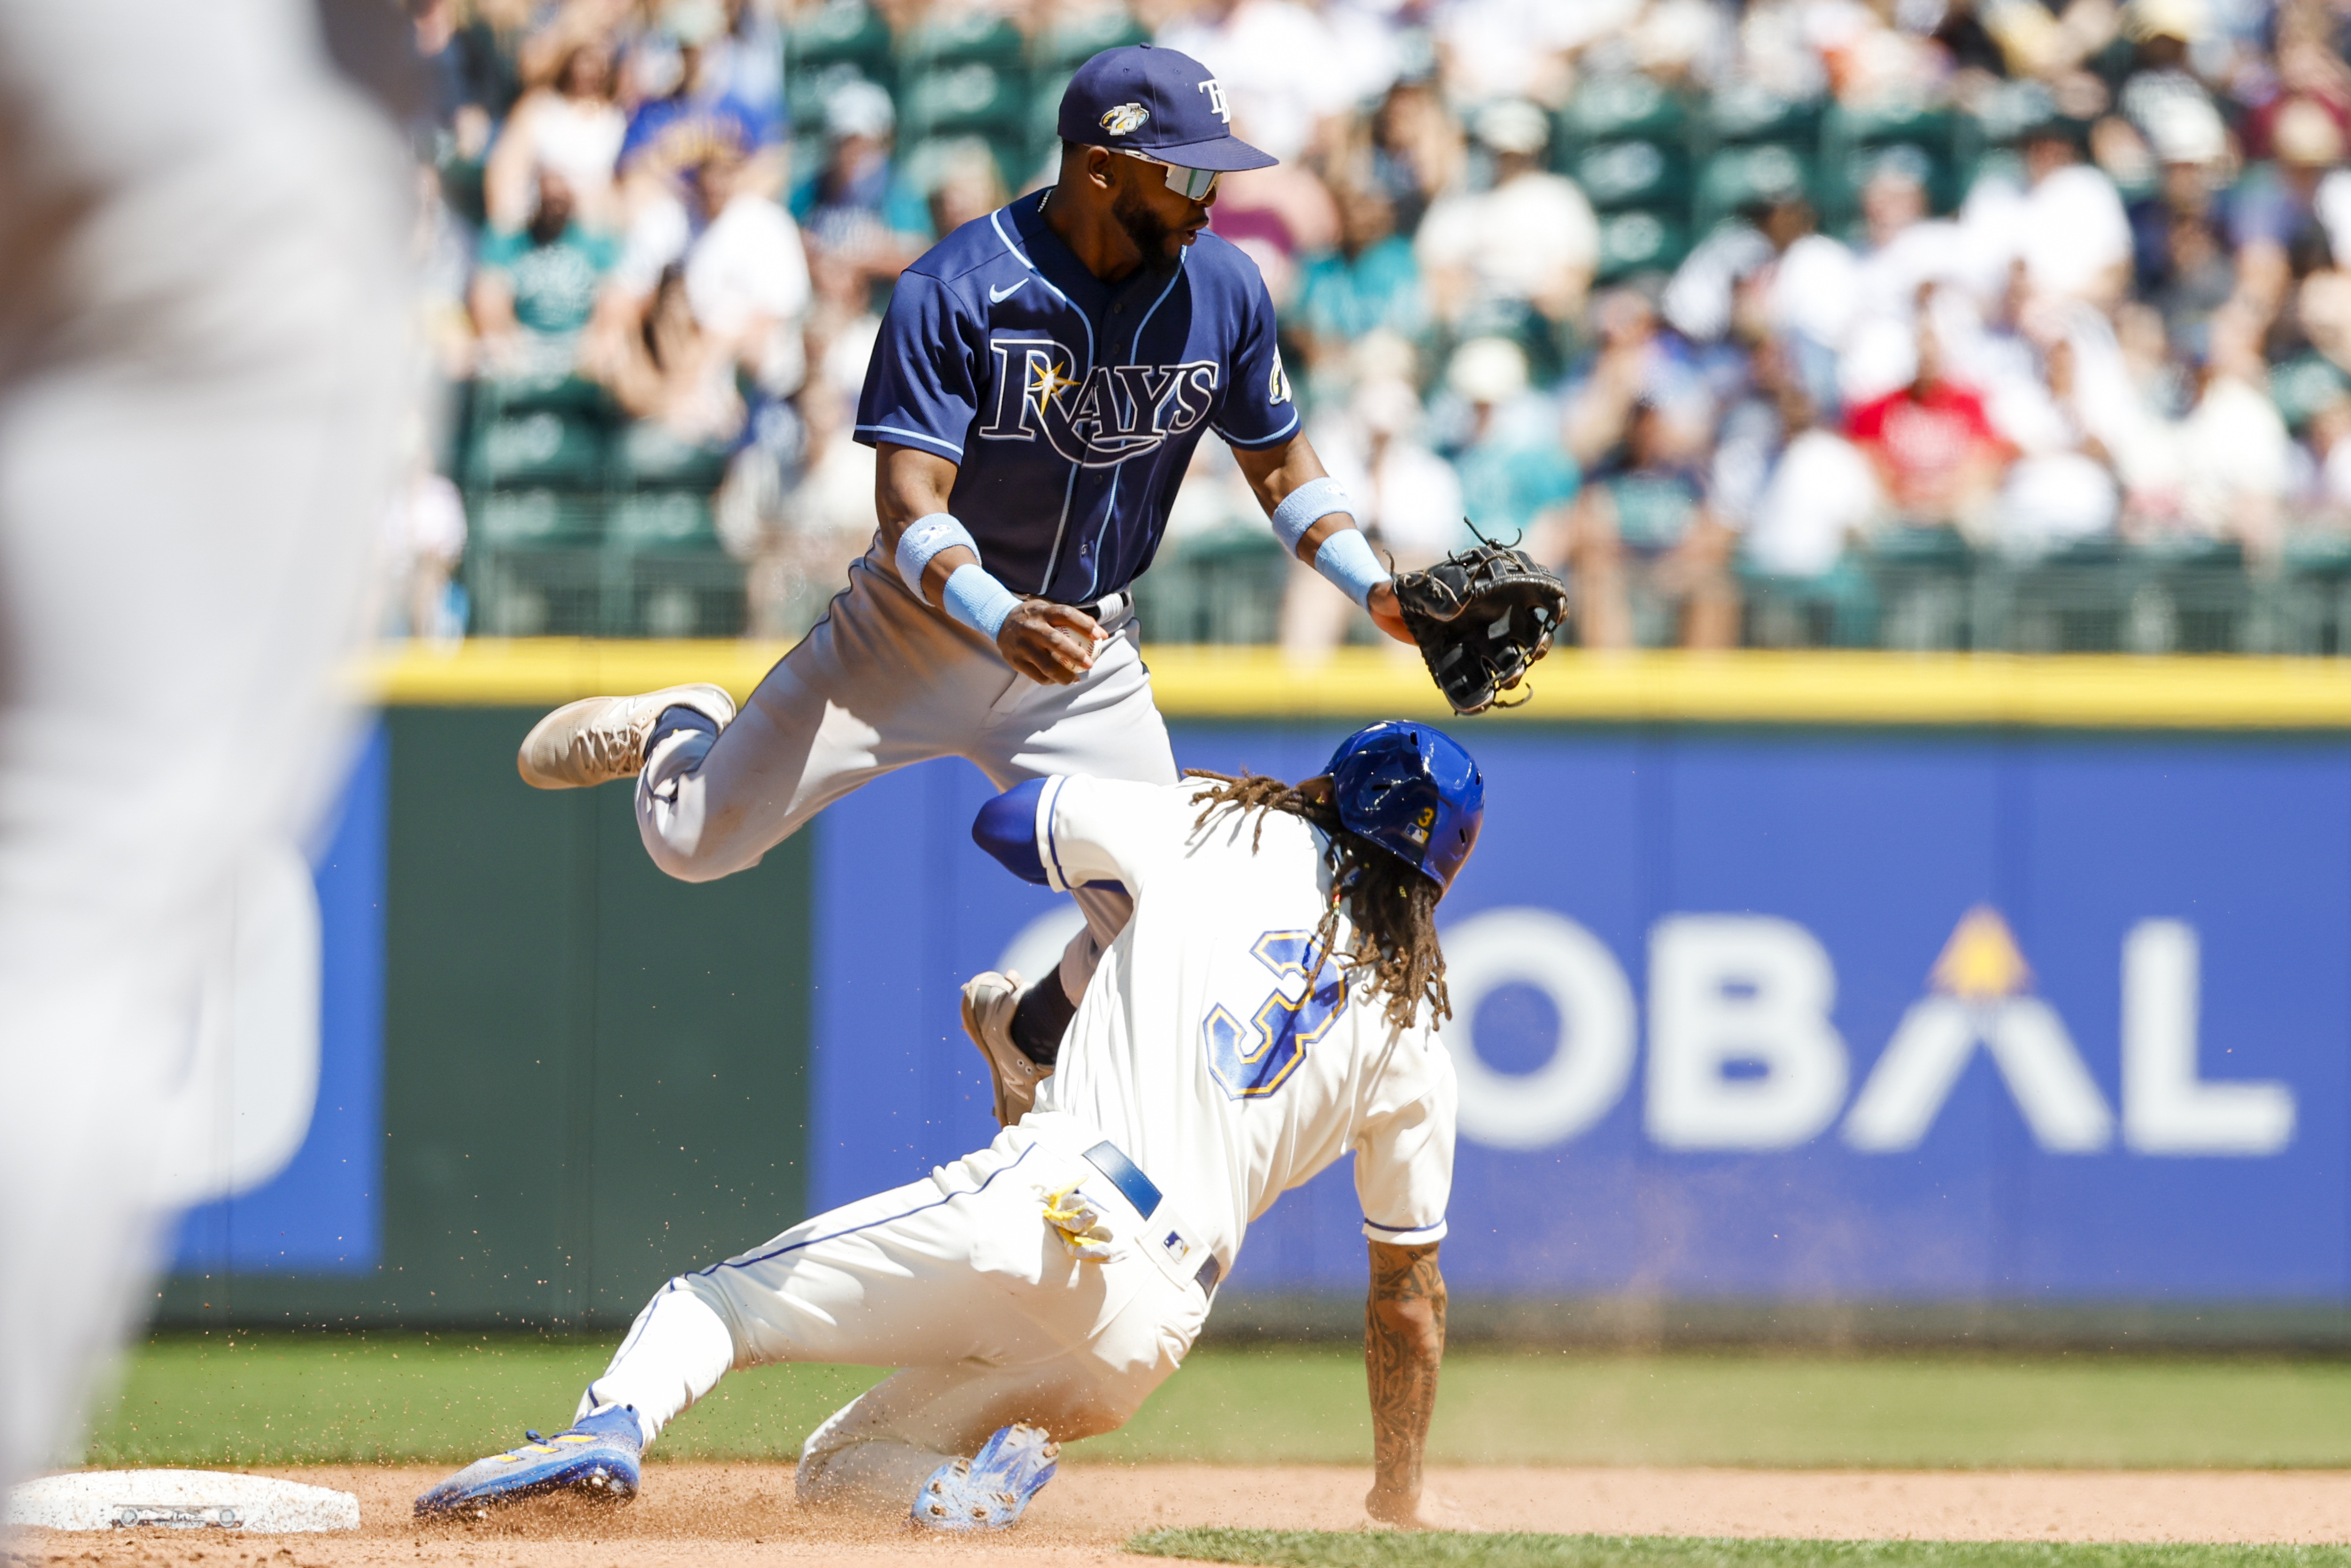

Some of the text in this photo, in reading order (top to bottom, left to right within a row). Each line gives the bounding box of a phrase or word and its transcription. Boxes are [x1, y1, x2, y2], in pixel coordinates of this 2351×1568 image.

[1109, 103, 1141, 136] 25
[1418, 807, 1434, 827] 3
[997, 905, 2296, 1154] OBAL
[1203, 929, 1349, 1101] 3
